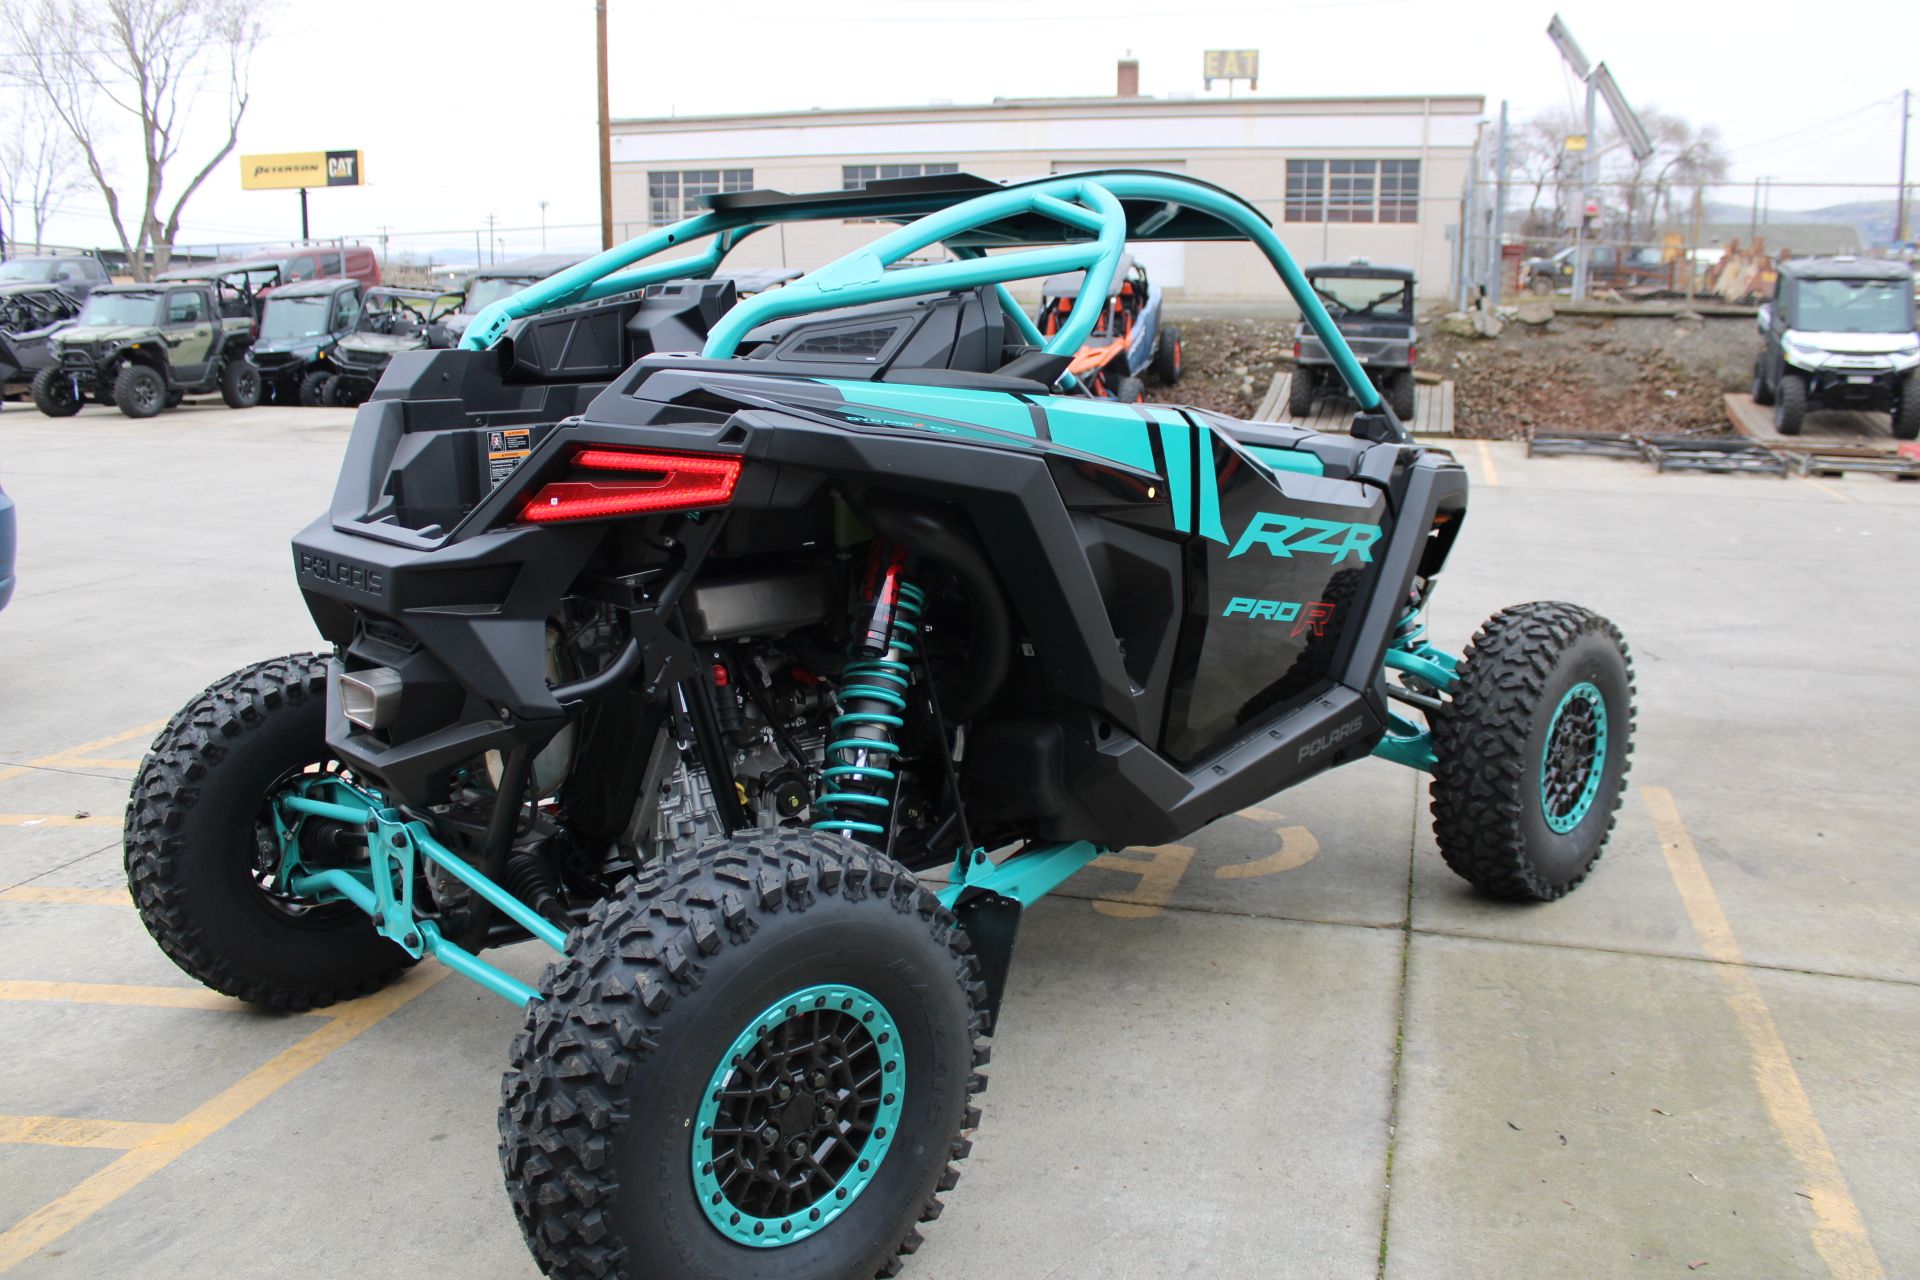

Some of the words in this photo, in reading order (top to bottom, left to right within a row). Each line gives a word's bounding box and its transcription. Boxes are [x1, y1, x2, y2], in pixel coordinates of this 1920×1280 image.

[1206, 52, 1257, 76] EAT
[328, 157, 354, 177] CAT
[1227, 511, 1383, 566] RZR
[301, 551, 382, 597] POLARIS
[1222, 596, 1302, 622] PRO
[1290, 602, 1336, 638] R
[1298, 715, 1363, 763] POLARIS
